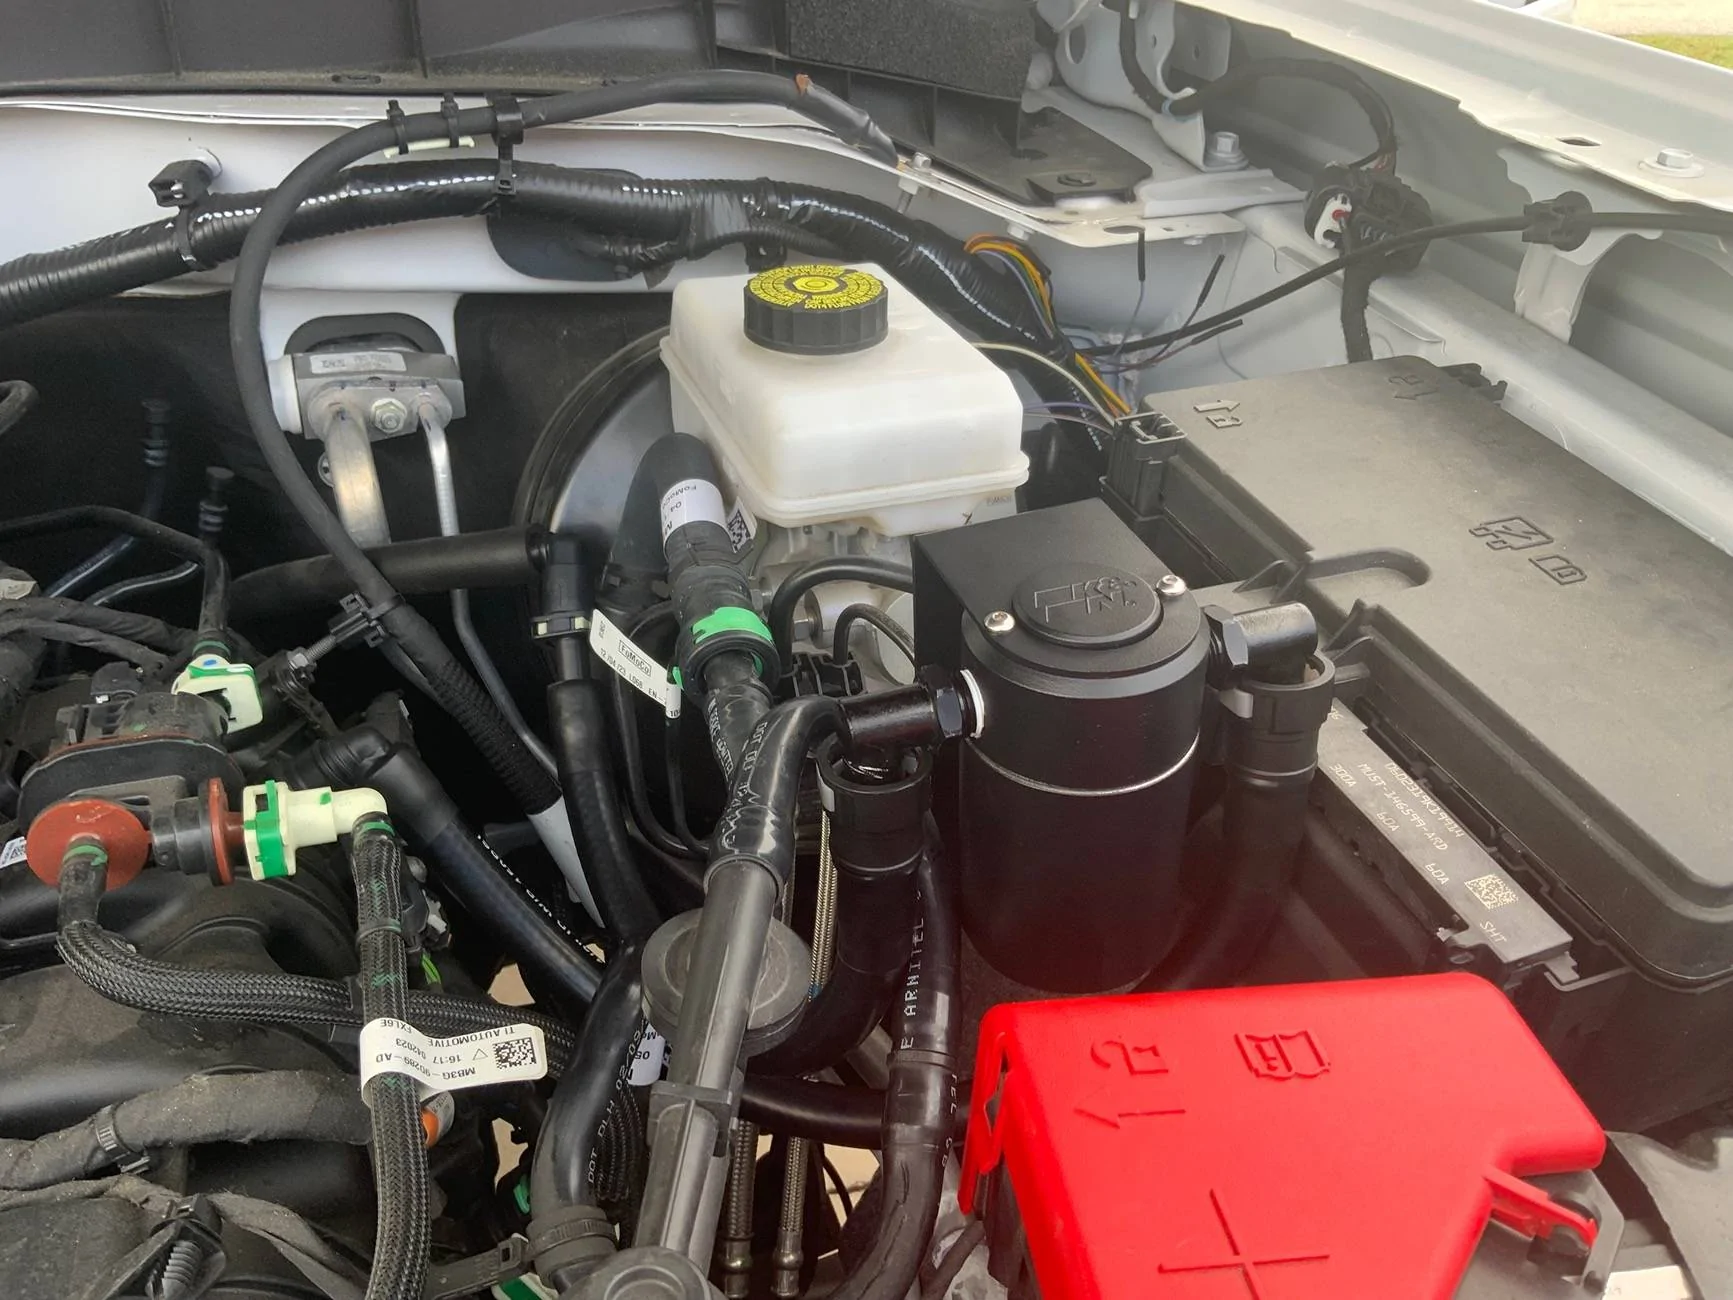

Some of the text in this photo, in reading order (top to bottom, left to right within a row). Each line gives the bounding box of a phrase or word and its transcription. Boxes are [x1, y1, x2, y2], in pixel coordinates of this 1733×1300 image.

[1329, 763, 1450, 886] 300A 60A 60A
[427, 1030, 501, 1048] AUTOMOTIVE
[432, 1053, 462, 1064] 16:17
